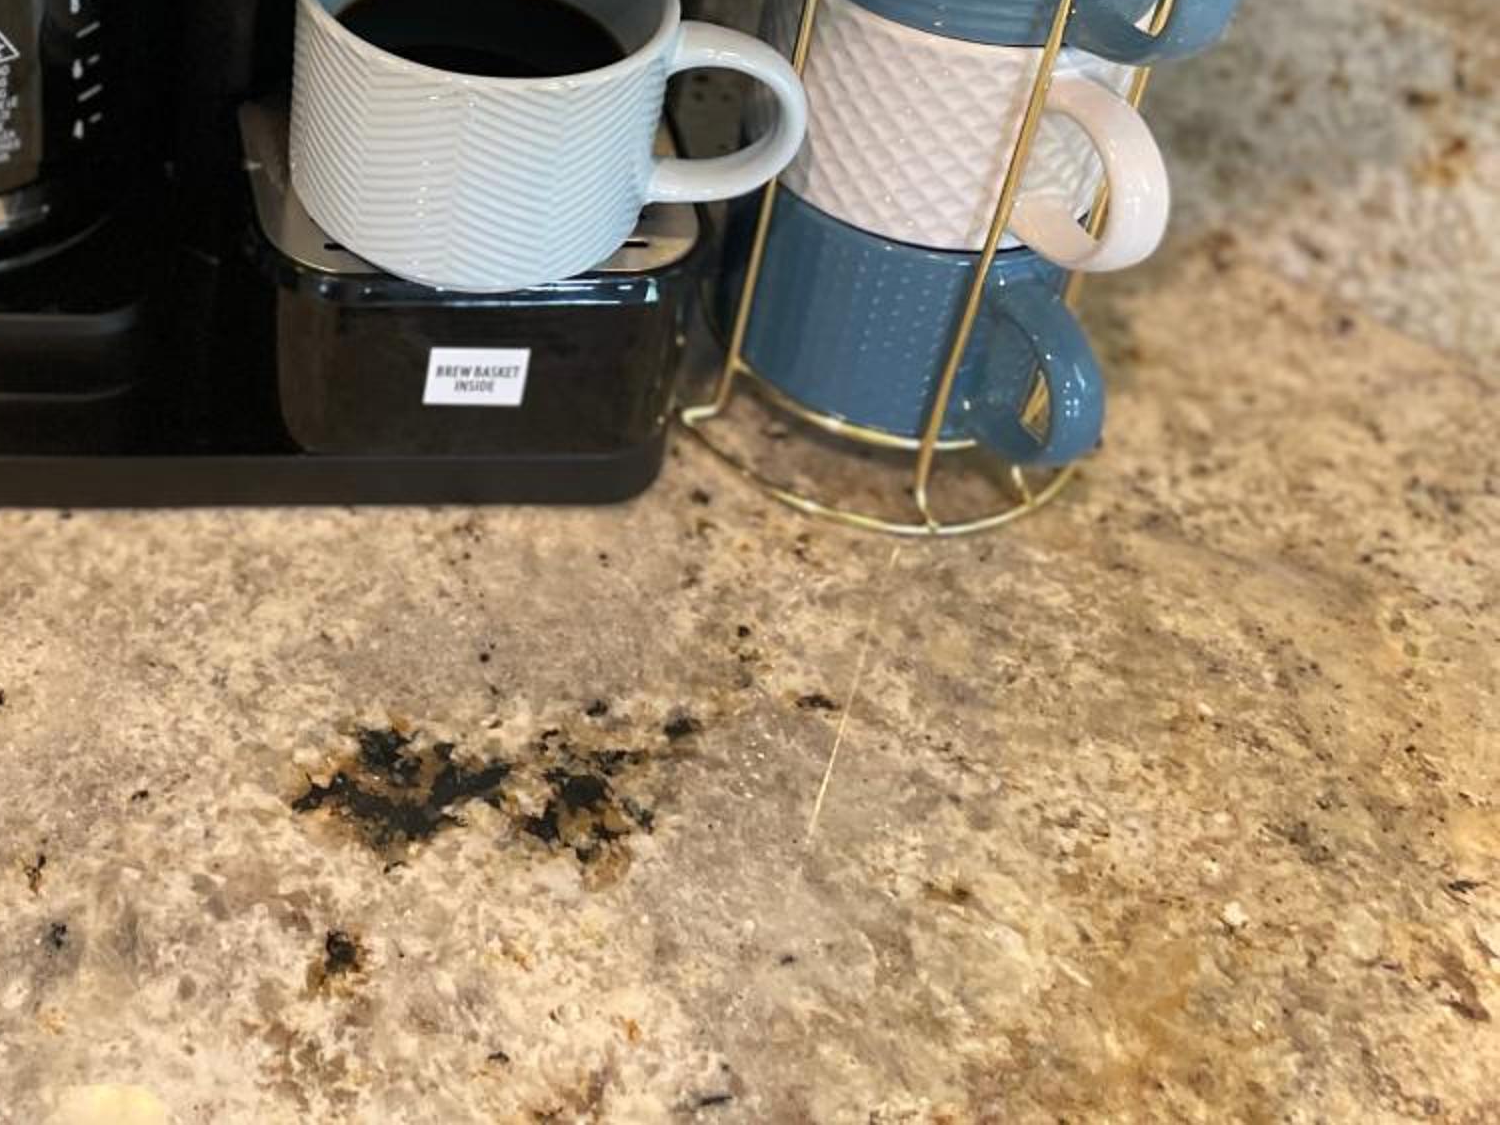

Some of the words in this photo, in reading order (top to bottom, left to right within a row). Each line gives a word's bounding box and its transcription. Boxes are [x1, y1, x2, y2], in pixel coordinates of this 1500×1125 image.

[435, 365, 472, 379] BREW
[472, 364, 520, 379] BASKET
[453, 380, 495, 393] INSIDE
